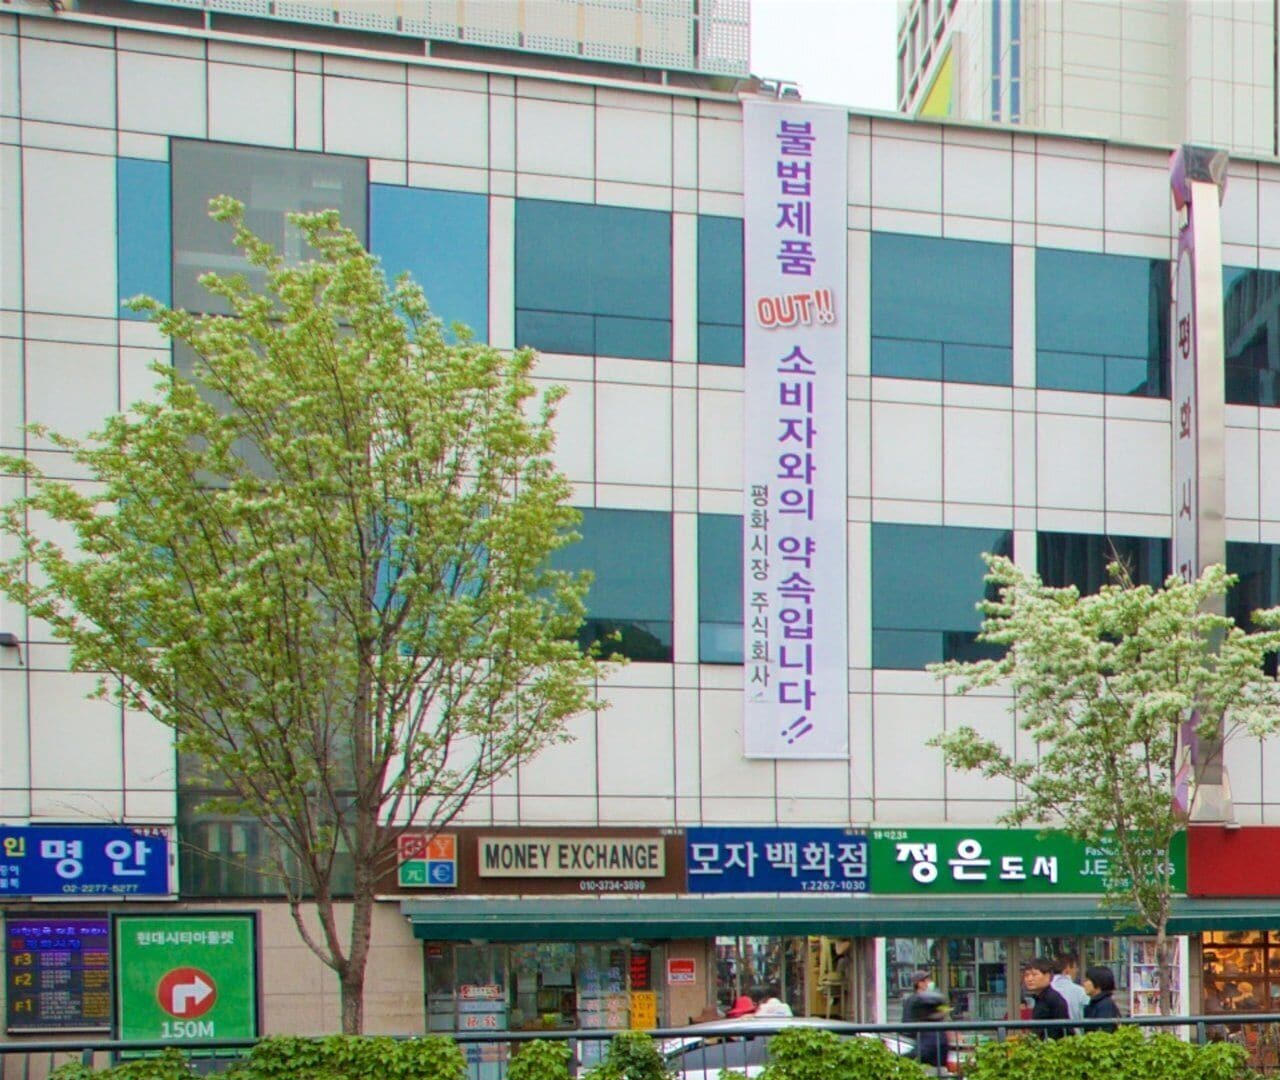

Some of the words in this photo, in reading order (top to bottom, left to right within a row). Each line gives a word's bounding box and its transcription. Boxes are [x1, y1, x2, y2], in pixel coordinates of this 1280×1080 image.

[776, 120, 816, 276] 불법제품
[757, 289, 834, 328] OUT!!
[776, 345, 817, 521] 소비자와의
[750, 484, 769, 581] 평화시장
[750, 592, 769, 686] 주식회사
[485, 844, 552, 870] MONEY
[557, 844, 660, 870] EXCHANGE
[161, 1021, 215, 1038] 150M
